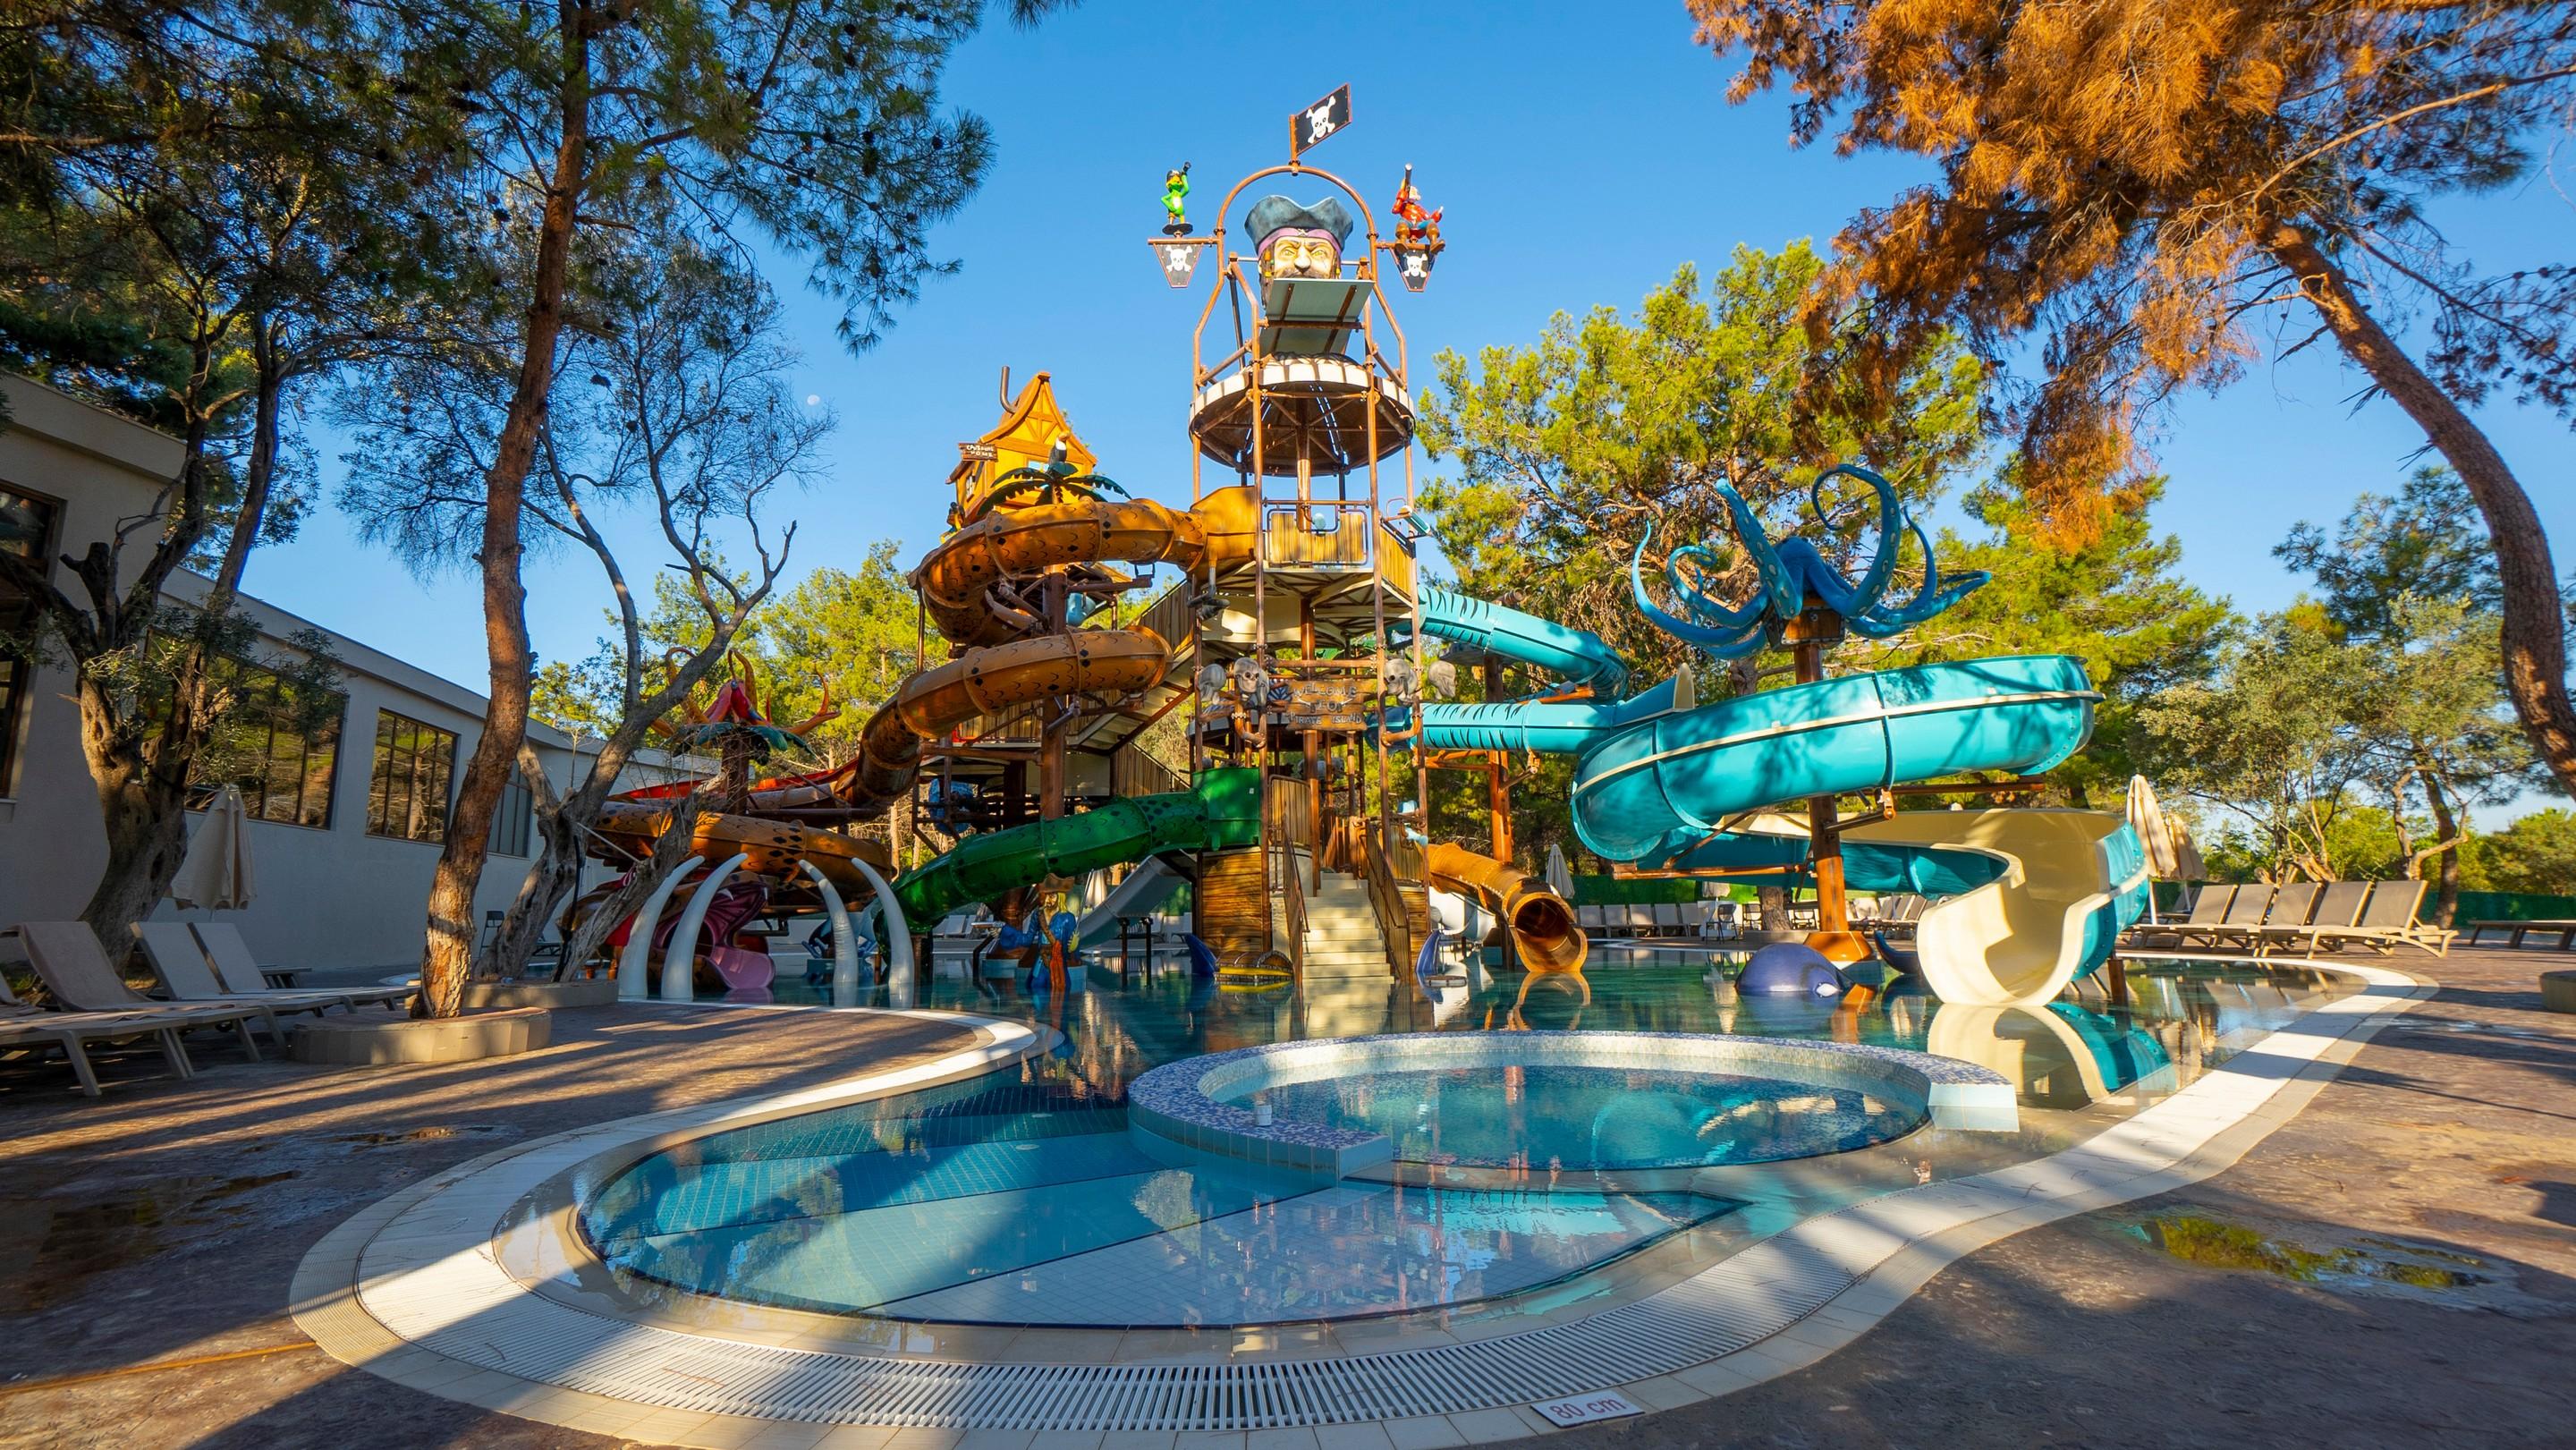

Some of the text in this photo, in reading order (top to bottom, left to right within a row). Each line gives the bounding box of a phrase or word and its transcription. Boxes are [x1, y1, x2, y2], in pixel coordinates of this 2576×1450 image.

[1293, 683, 1357, 698] WELCOME
[1290, 711, 1361, 724] PIRATE ISLAND
[1549, 1398, 1627, 1419] 80 cm
